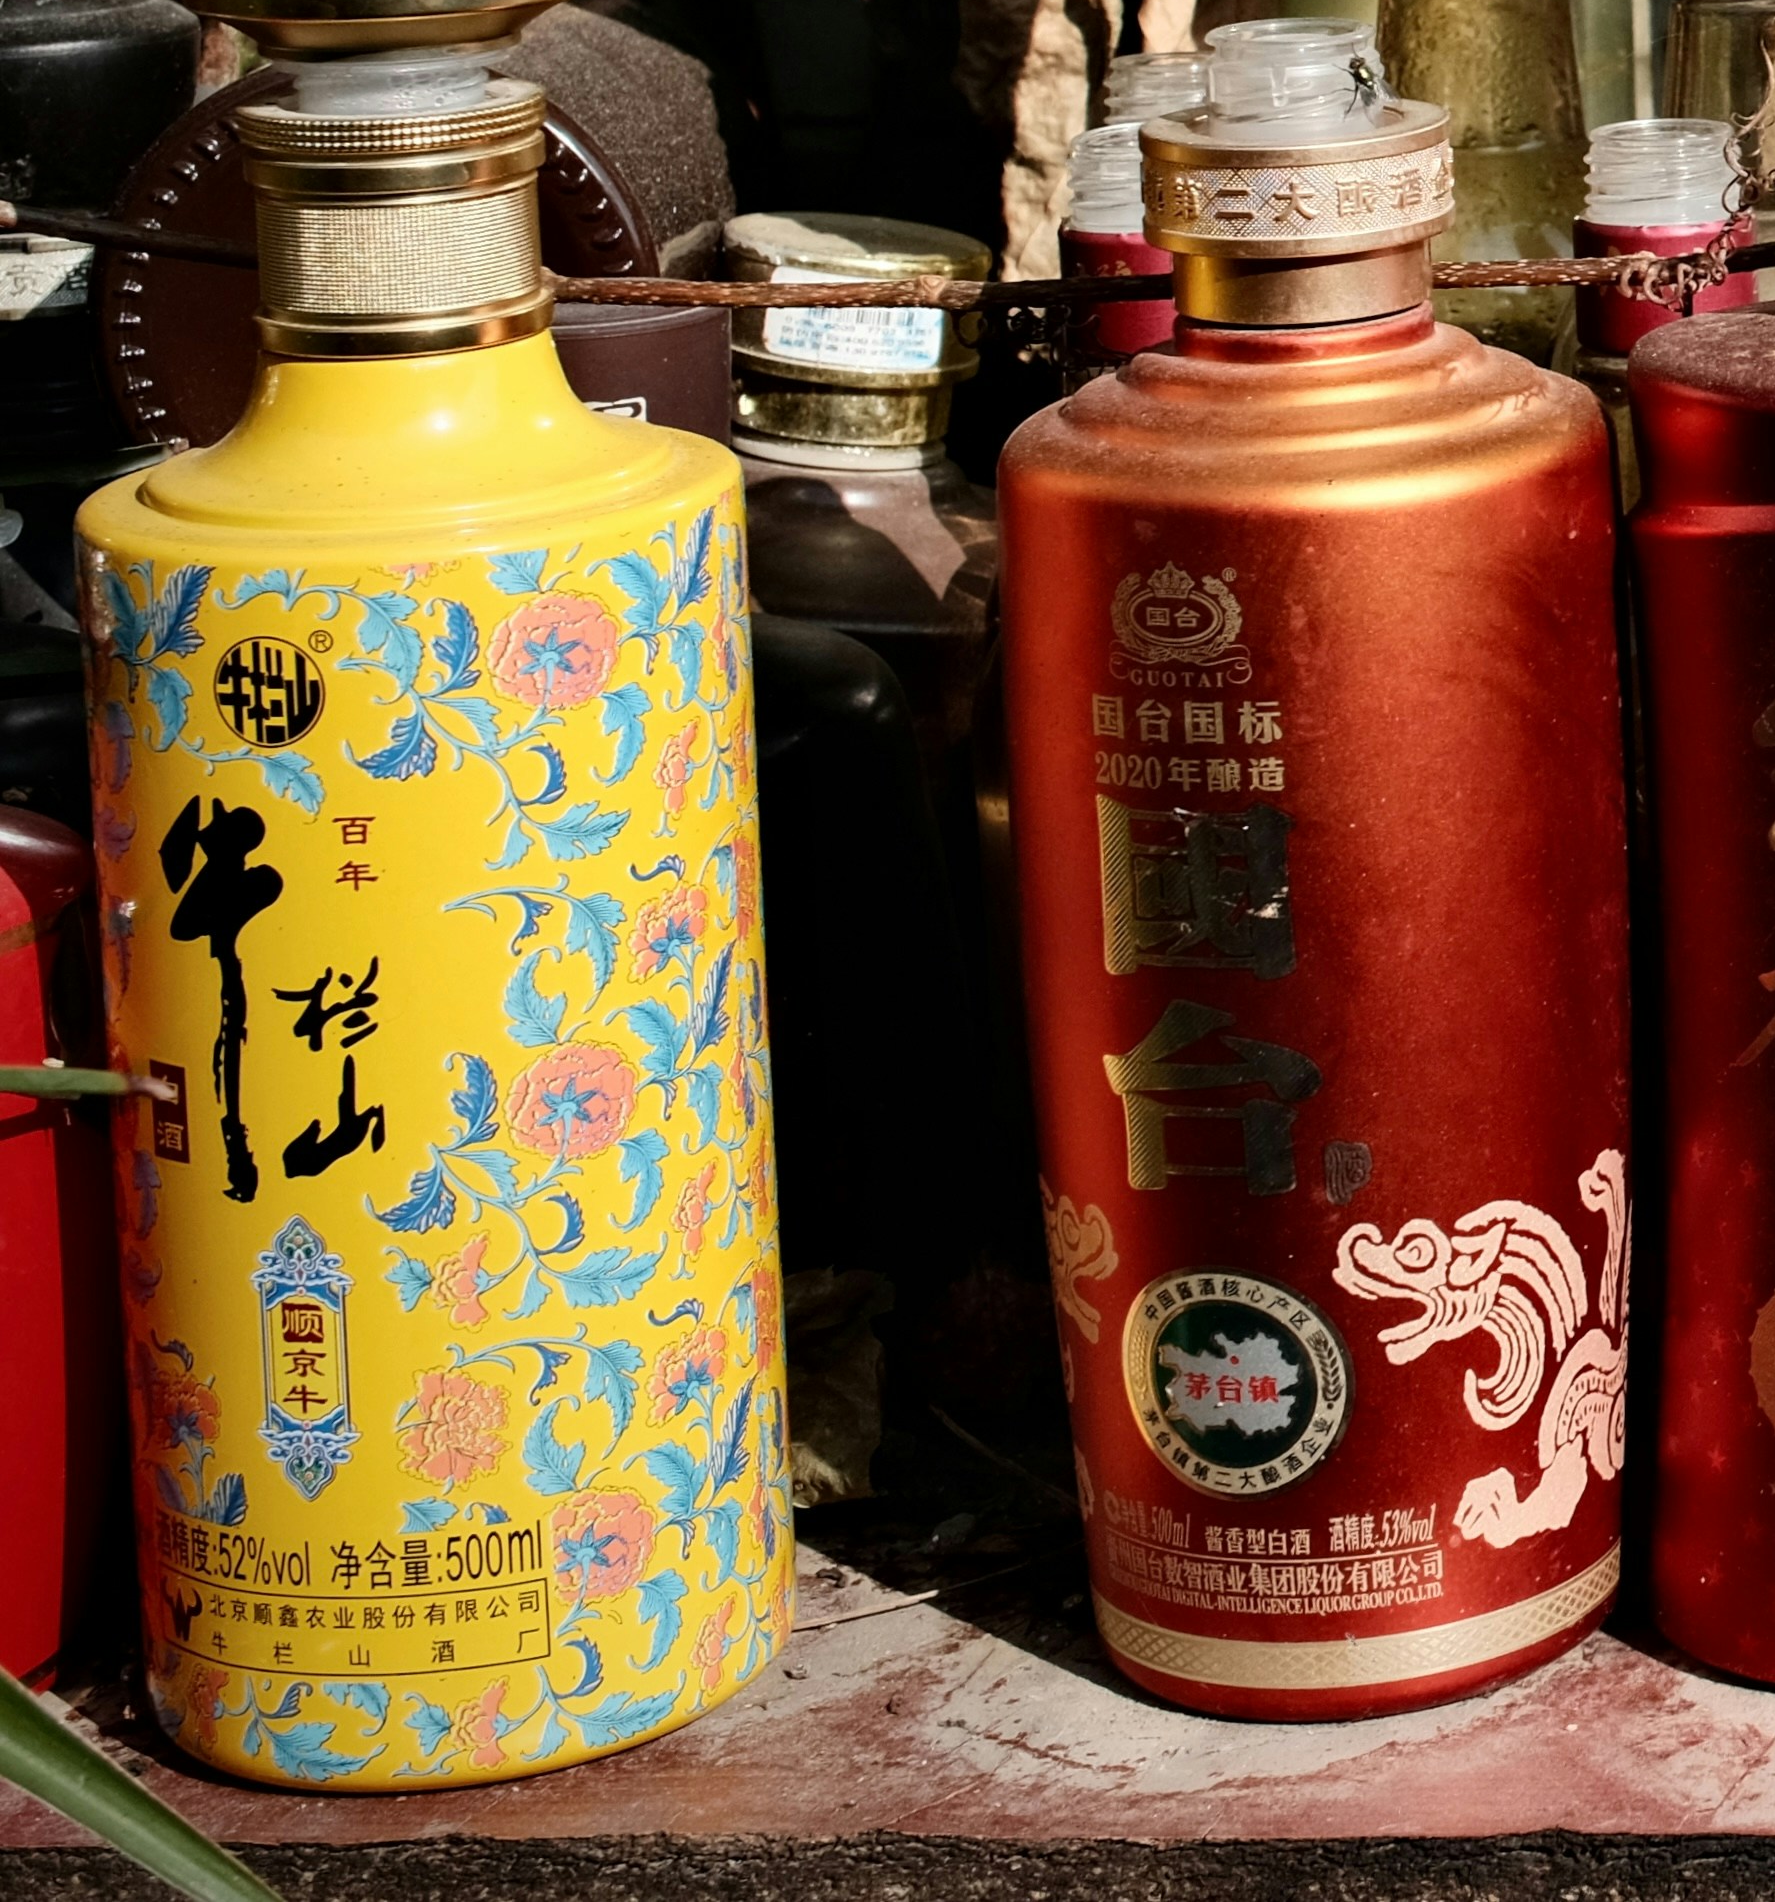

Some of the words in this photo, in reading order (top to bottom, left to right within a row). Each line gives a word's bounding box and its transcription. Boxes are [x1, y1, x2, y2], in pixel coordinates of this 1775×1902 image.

[1146, 606, 1201, 629] 国台
[1129, 668, 1225, 689] GUOTAI
[1092, 692, 1284, 745] 国台国标
[1095, 750, 1286, 794] 2020年酿造
[332, 814, 379, 893] 百年
[281, 1302, 329, 1416] 顺京牛
[1184, 1372, 1280, 1403] 茅台镇
[1143, 1408, 1335, 1490] 茅台镇第二大酿酒企业
[156, 1507, 312, 1587] 酒精度:52%vol
[330, 1519, 542, 1591] 净含量:500ml
[1204, 1524, 1311, 1556] 酱香型白酒
[1328, 1502, 1437, 1554] 酒精度:53%vol
[209, 1589, 542, 1631] 北京顺鑫农业股份有限公司
[1304, 1596, 1352, 1617] LIQUOR
[1350, 1590, 1397, 1612] GROUP
[210, 1627, 542, 1669] 牛栏山酒厂
